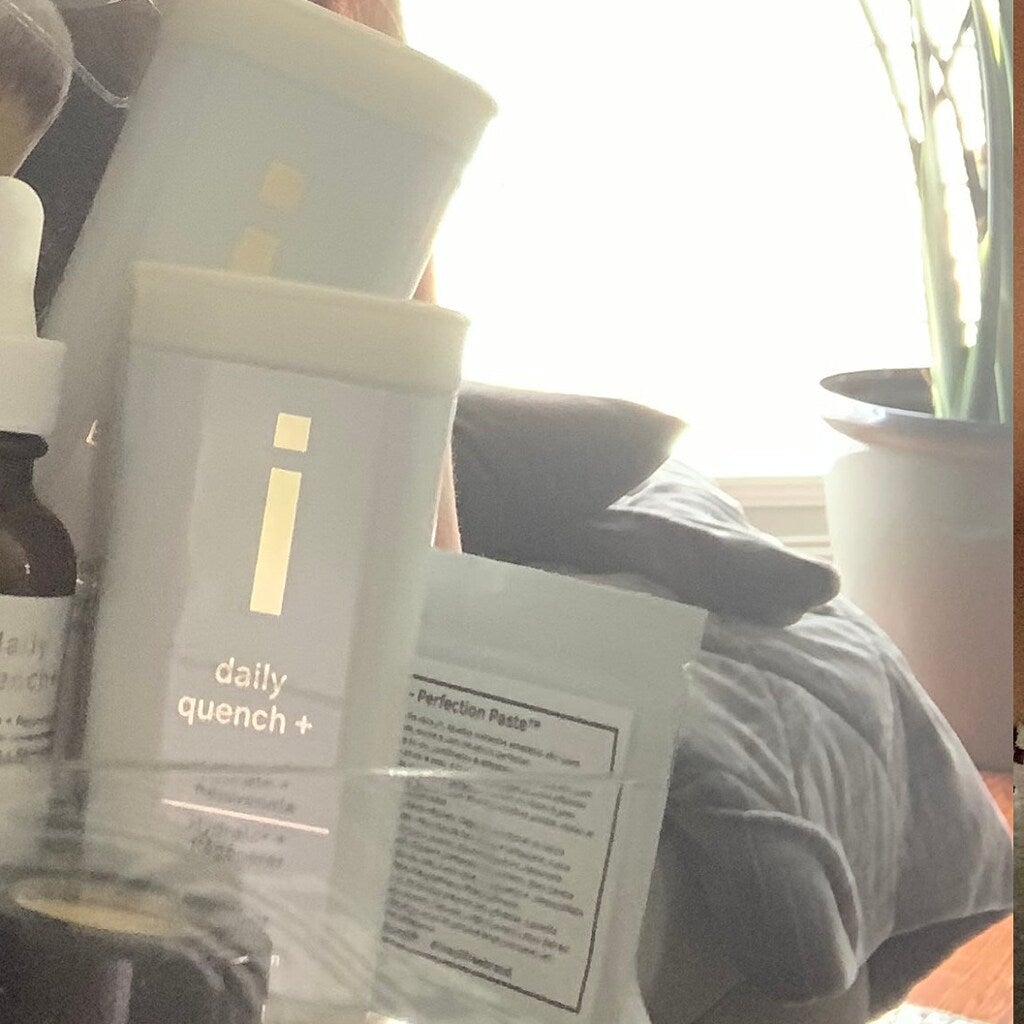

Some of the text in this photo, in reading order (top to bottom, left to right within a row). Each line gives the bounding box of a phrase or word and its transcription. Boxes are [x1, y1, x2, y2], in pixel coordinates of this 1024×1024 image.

[215, 657, 288, 700] daily
[178, 695, 287, 734] quench
[417, 689, 486, 721] Perfection
